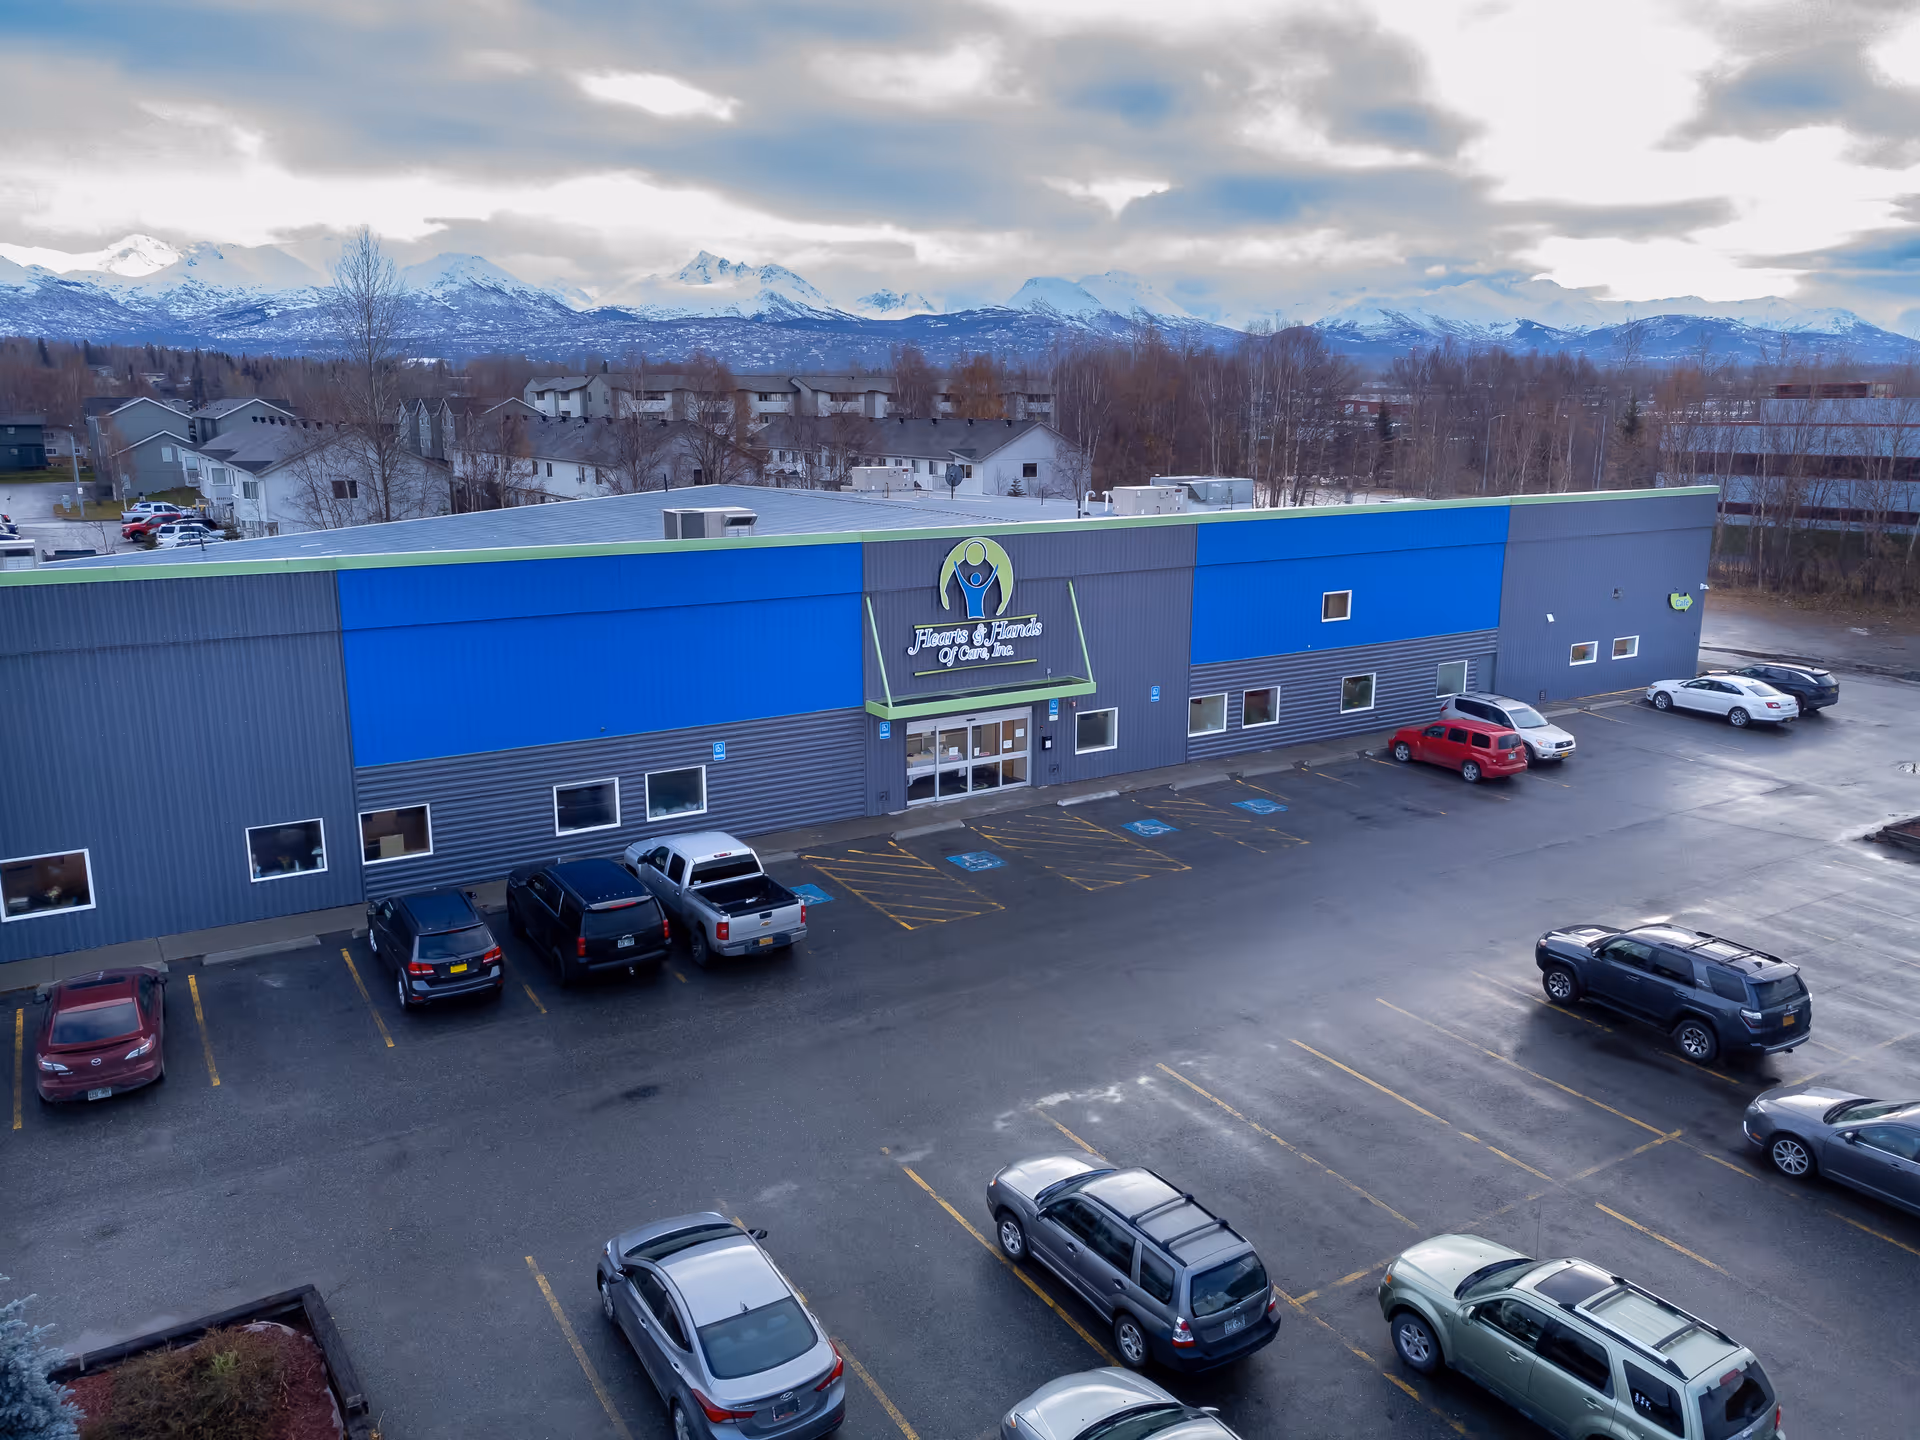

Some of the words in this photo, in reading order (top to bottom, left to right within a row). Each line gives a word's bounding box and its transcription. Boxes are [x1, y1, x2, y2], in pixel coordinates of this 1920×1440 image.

[907, 628, 969, 656] Hearts
[972, 623, 987, 646] &
[984, 618, 1043, 647] Hands
[938, 646, 959, 667] Of
[958, 645, 990, 661] Care,
[991, 642, 1015, 657] Inc.
